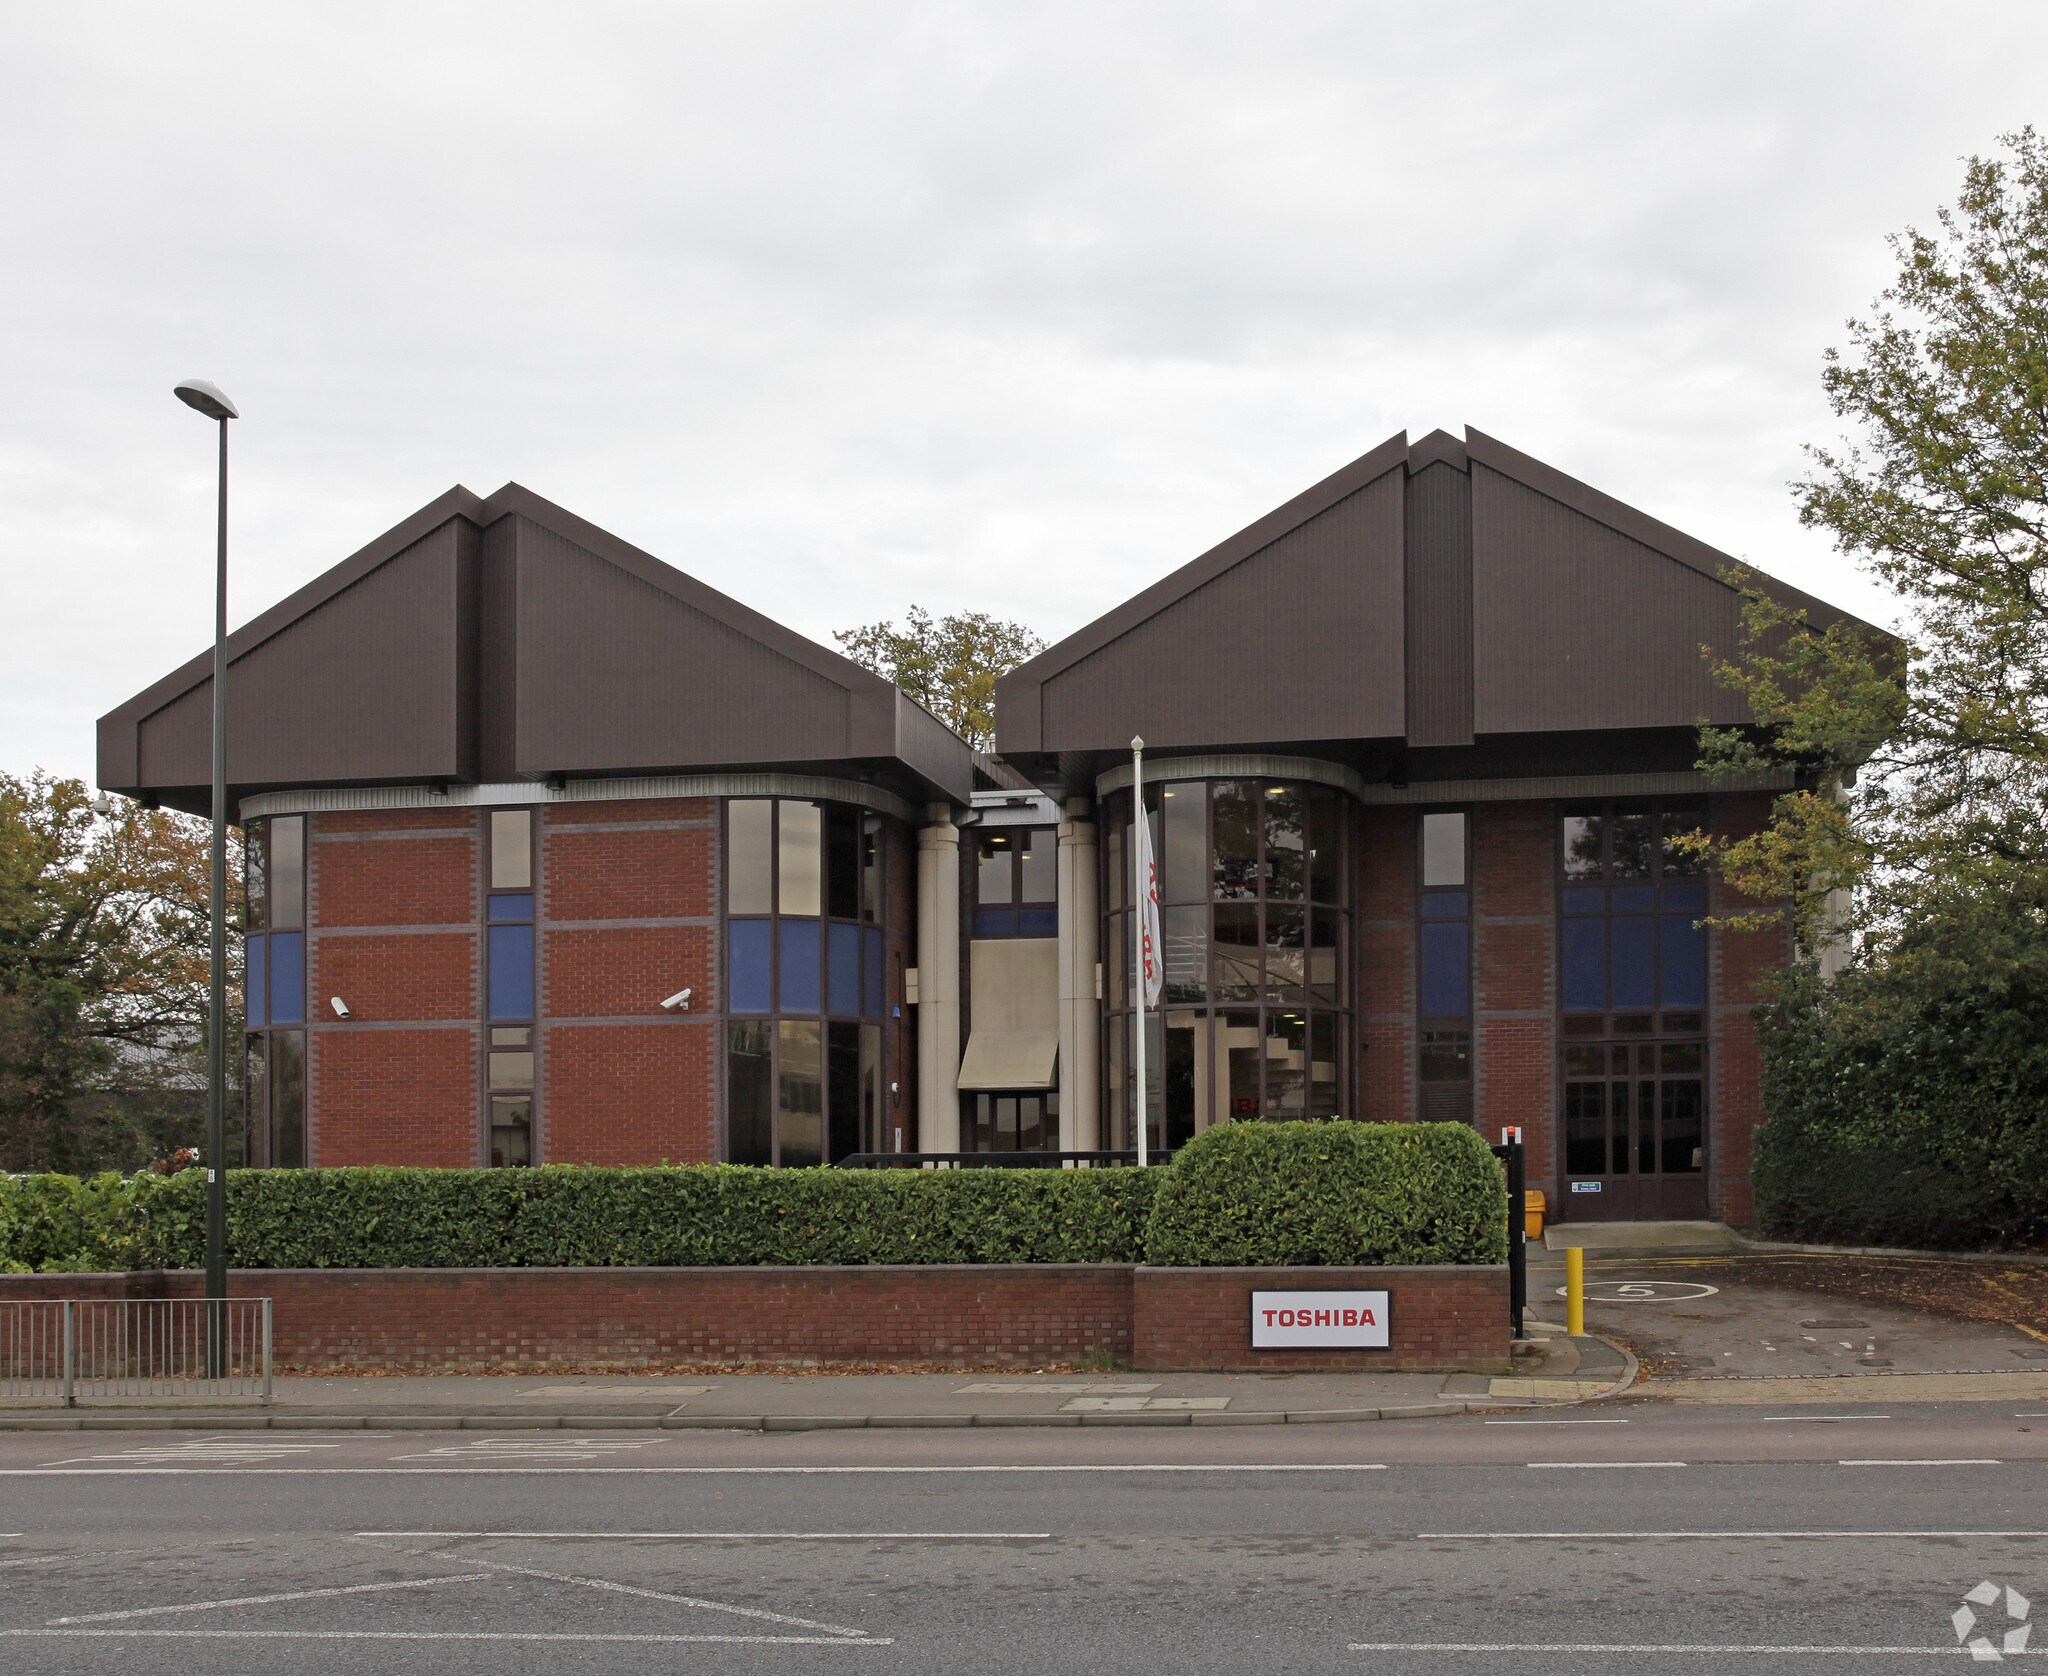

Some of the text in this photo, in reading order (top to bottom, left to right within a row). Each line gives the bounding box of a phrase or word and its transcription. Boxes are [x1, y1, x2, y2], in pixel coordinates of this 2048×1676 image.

[1617, 1284, 1656, 1297] 5
[1262, 1309, 1376, 1327] TOSHIBA
[36, 1435, 394, 1467] LANE
[387, 1438, 673, 1462] BUS
